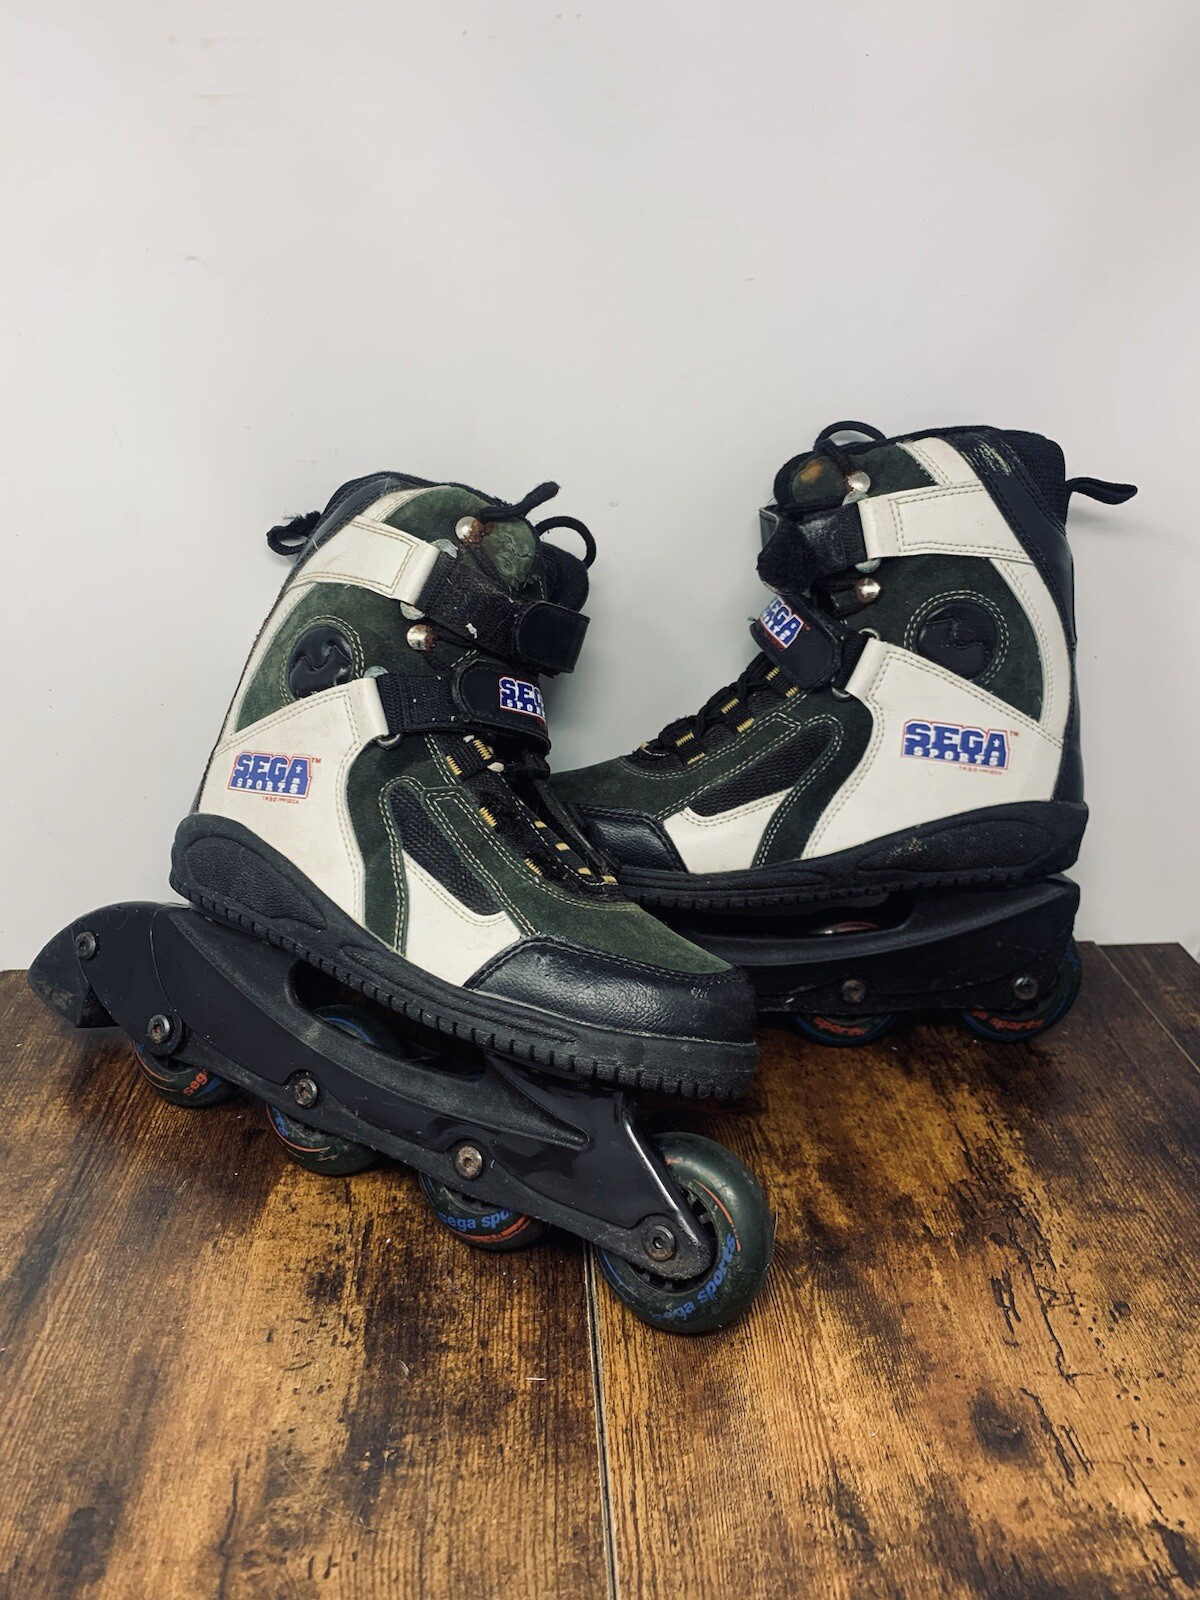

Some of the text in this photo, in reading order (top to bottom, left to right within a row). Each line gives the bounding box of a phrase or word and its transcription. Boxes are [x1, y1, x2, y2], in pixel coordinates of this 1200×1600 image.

[904, 720, 1007, 758] SEGA
[232, 752, 311, 786] SEGA
[913, 746, 1000, 766] SPORTS
[236, 777, 300, 795] SPORTS
[182, 1068, 208, 1096] seg
